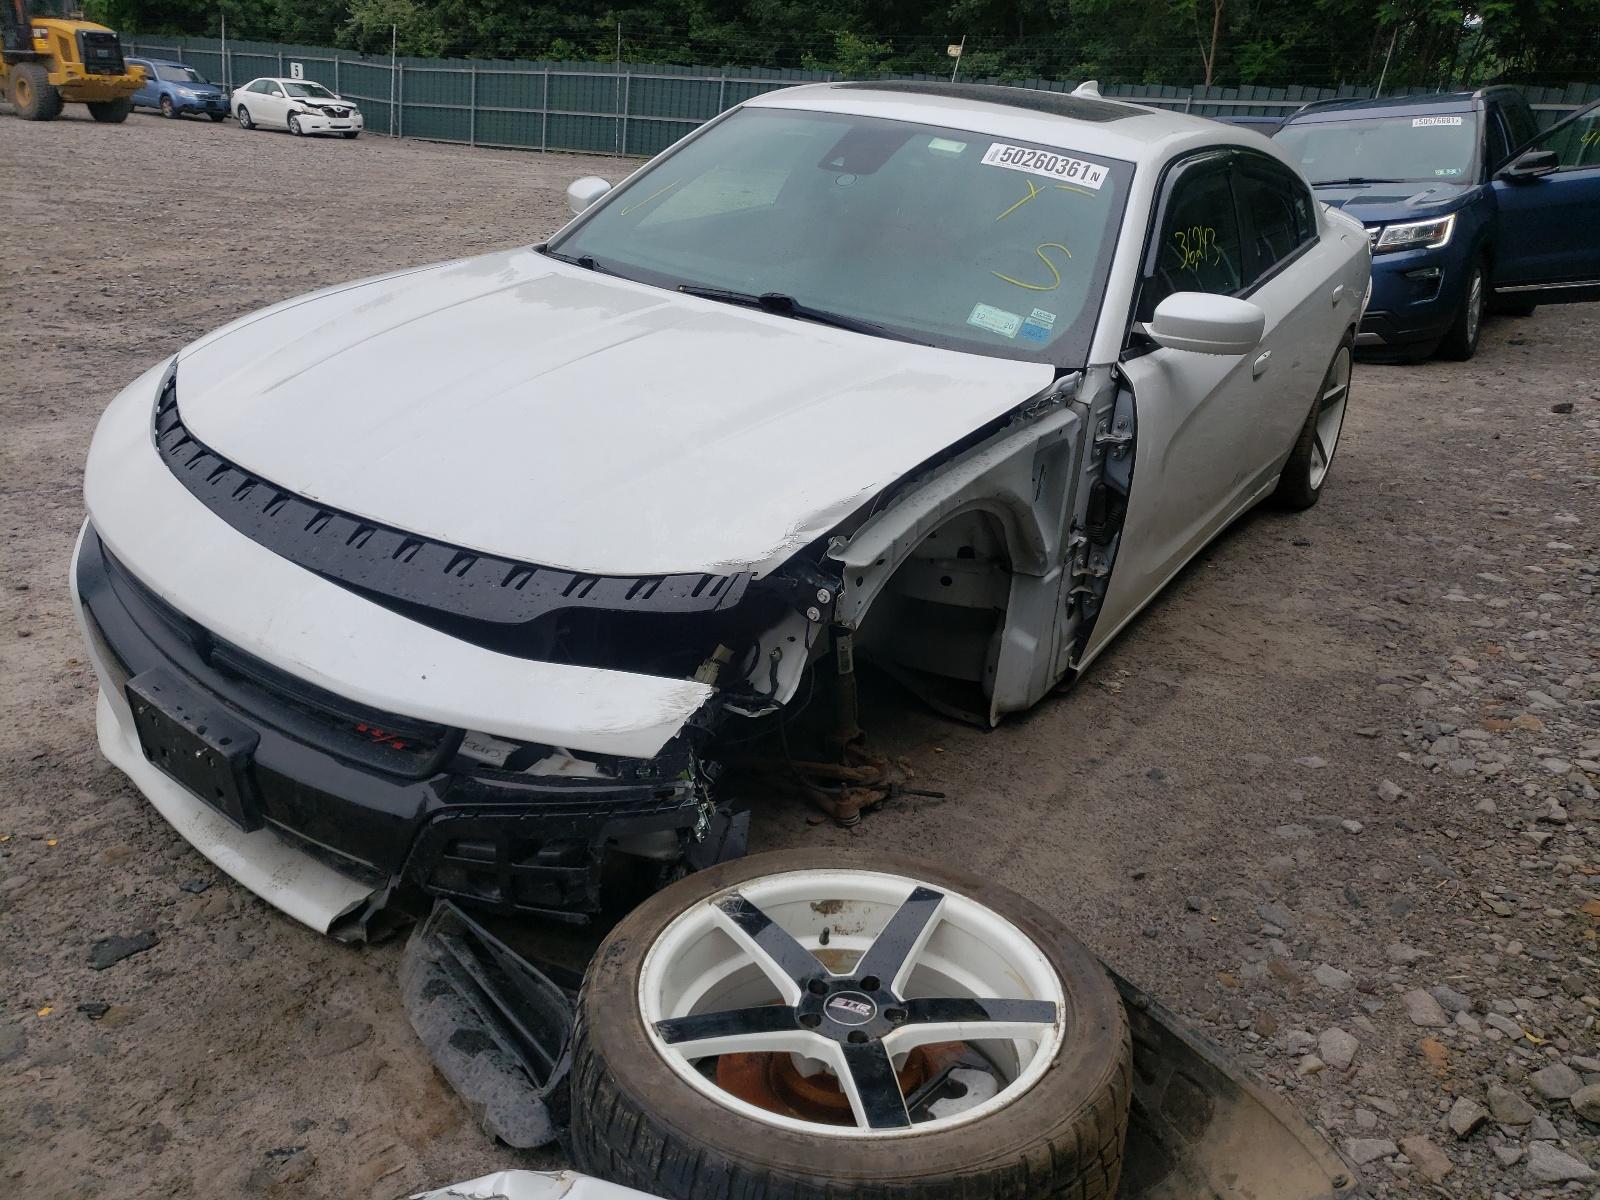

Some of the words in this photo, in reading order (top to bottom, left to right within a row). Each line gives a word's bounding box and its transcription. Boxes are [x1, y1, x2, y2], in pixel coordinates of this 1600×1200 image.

[999, 146, 1091, 181] 50260361
[1089, 171, 1101, 183] N
[976, 312, 986, 320] 12
